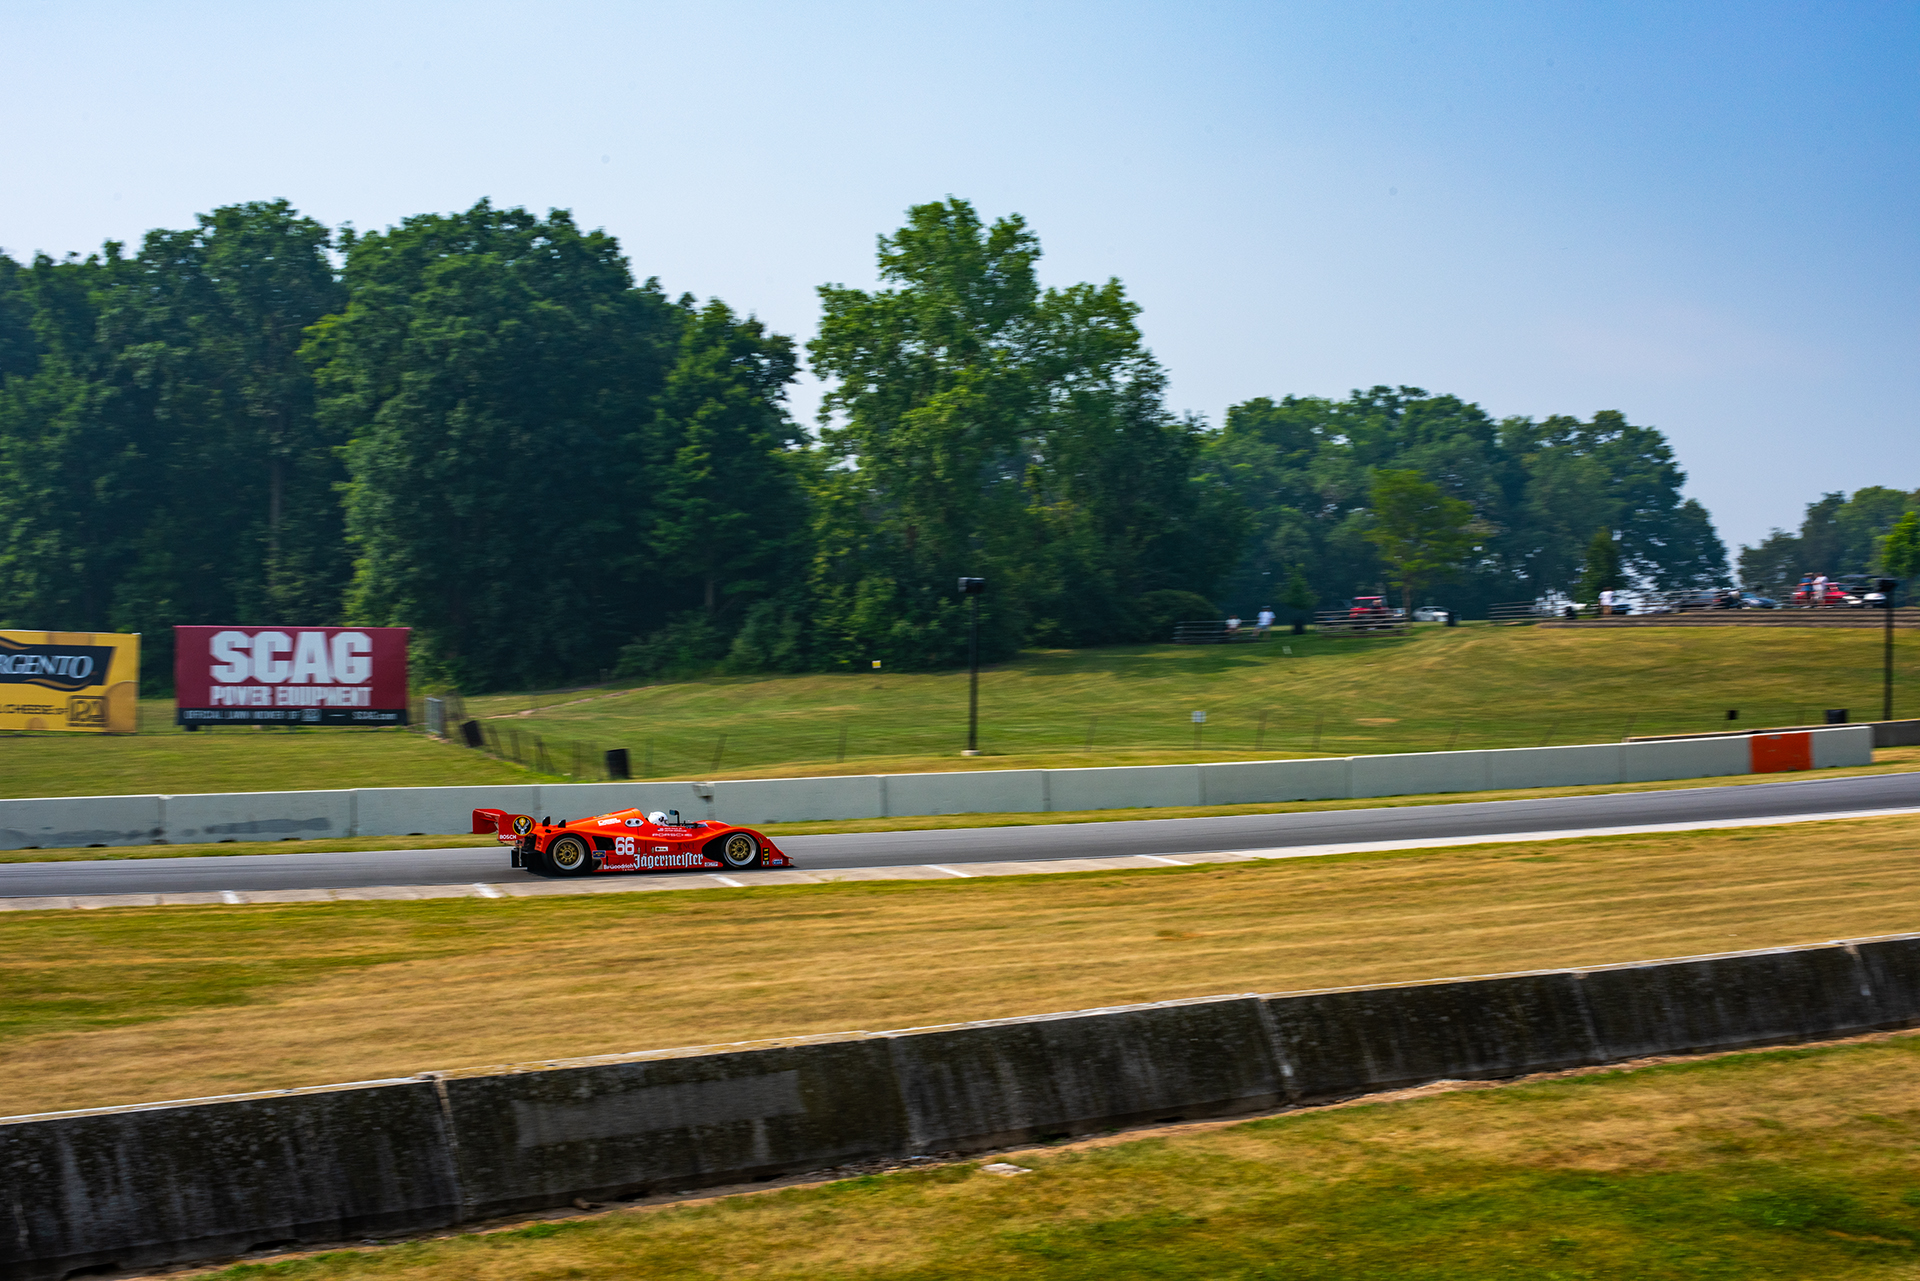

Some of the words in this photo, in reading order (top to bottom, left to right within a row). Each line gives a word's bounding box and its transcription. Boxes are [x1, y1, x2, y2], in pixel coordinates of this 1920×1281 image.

[209, 630, 373, 684] SCAG
[209, 685, 273, 706] POWER
[275, 686, 373, 707] EQUIPMENT
[615, 837, 635, 855] 66
